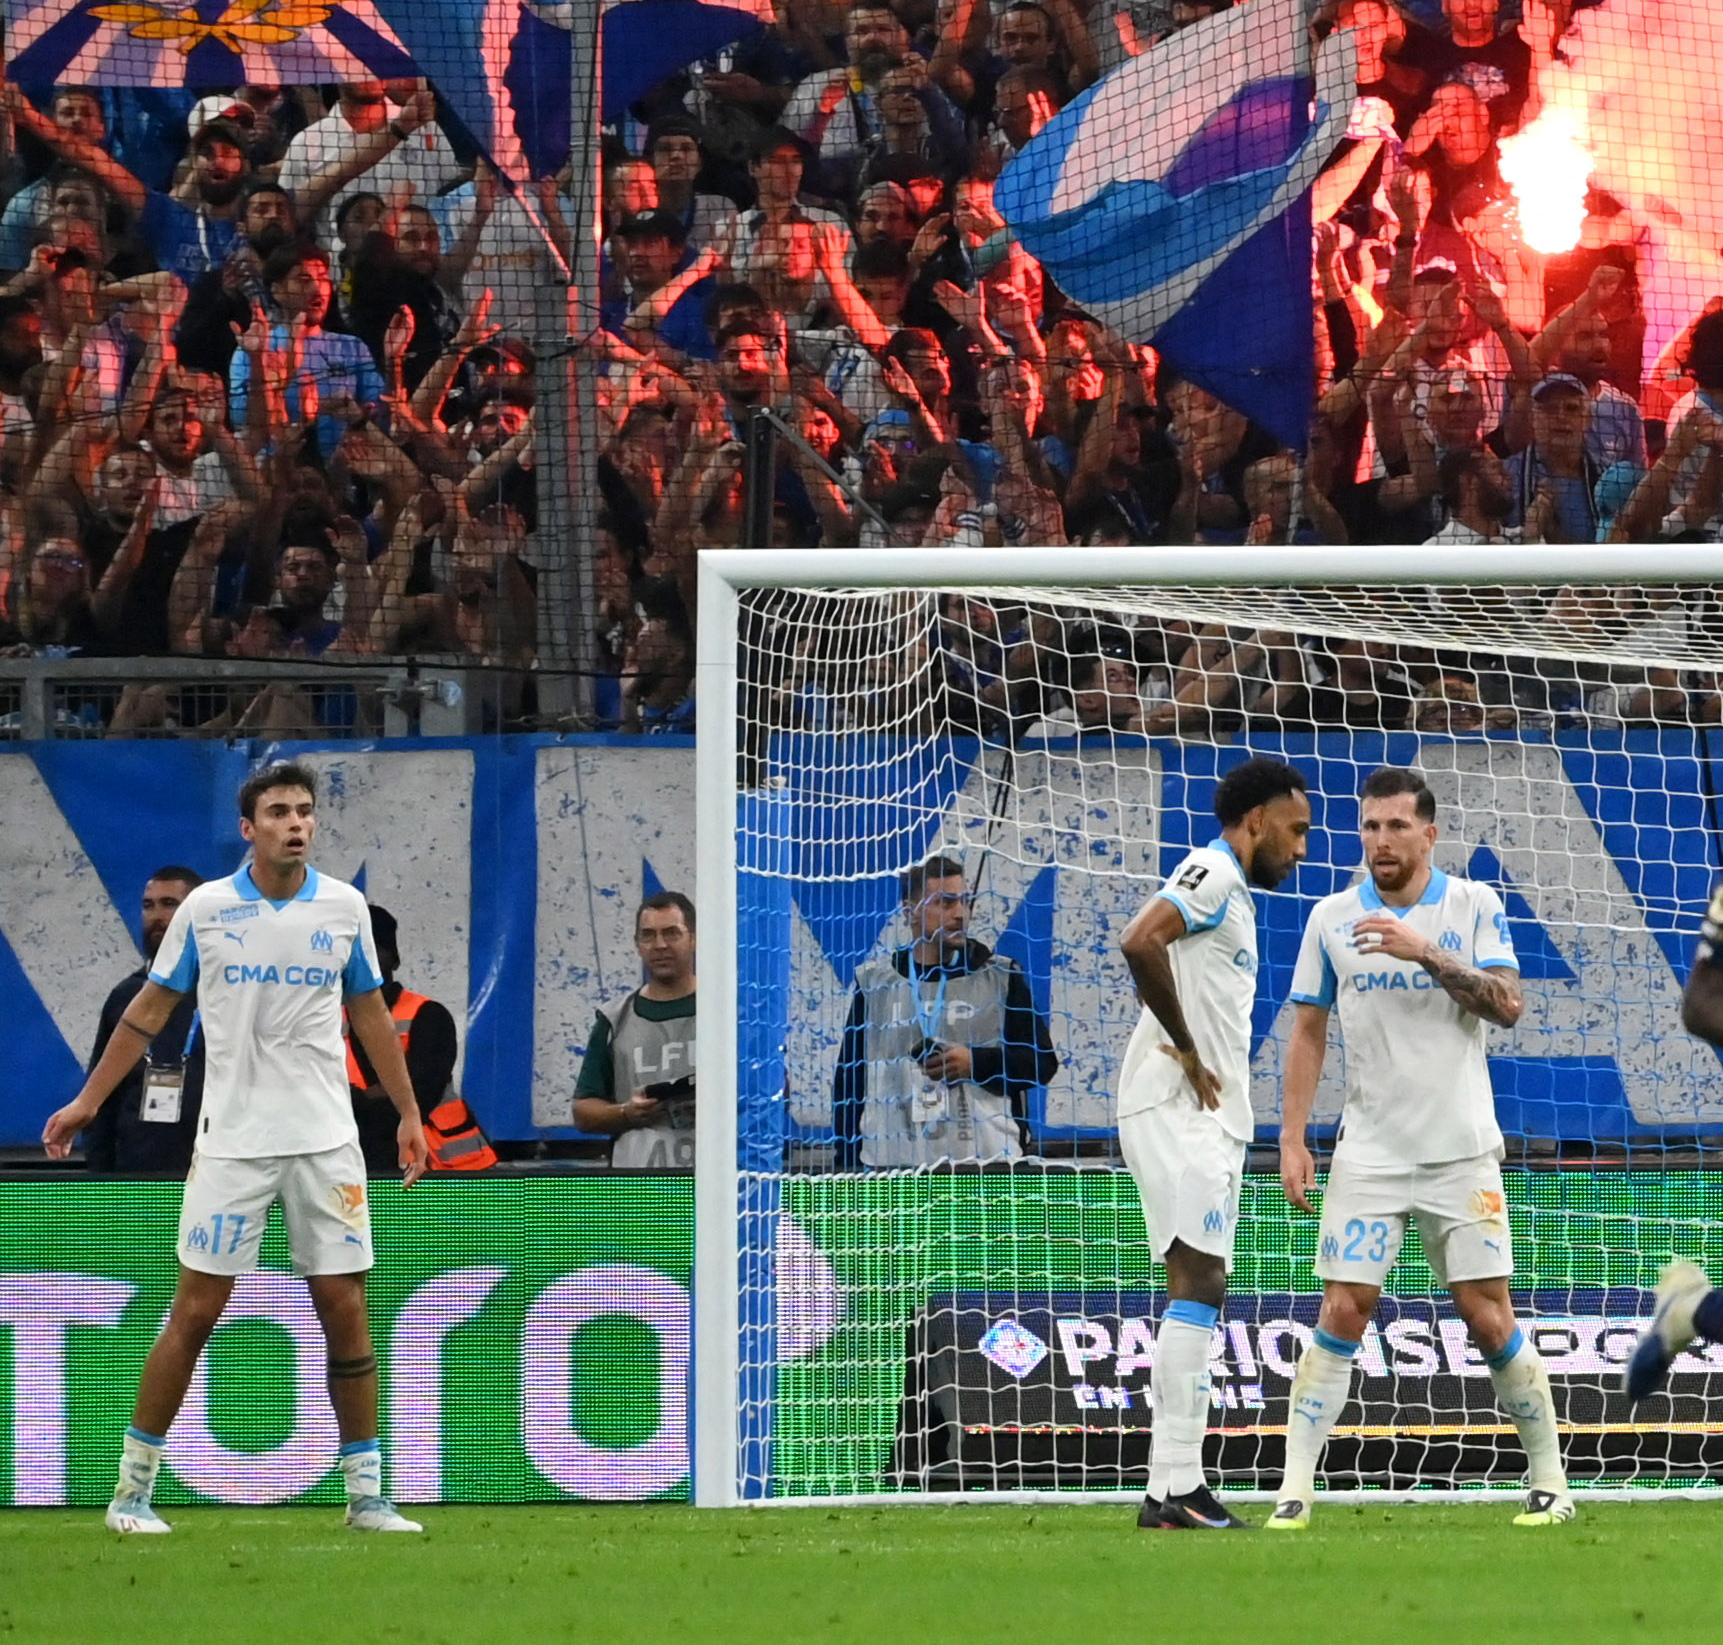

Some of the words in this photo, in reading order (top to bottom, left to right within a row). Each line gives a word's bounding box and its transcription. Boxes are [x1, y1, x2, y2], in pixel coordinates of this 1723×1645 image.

[223, 964, 280, 985] CMA
[284, 965, 338, 987] CGM
[1353, 971, 1409, 993] CMA
[210, 1213, 248, 1255] 17
[1343, 1217, 1390, 1263] 23
[1075, 1384, 1132, 1410] EN
